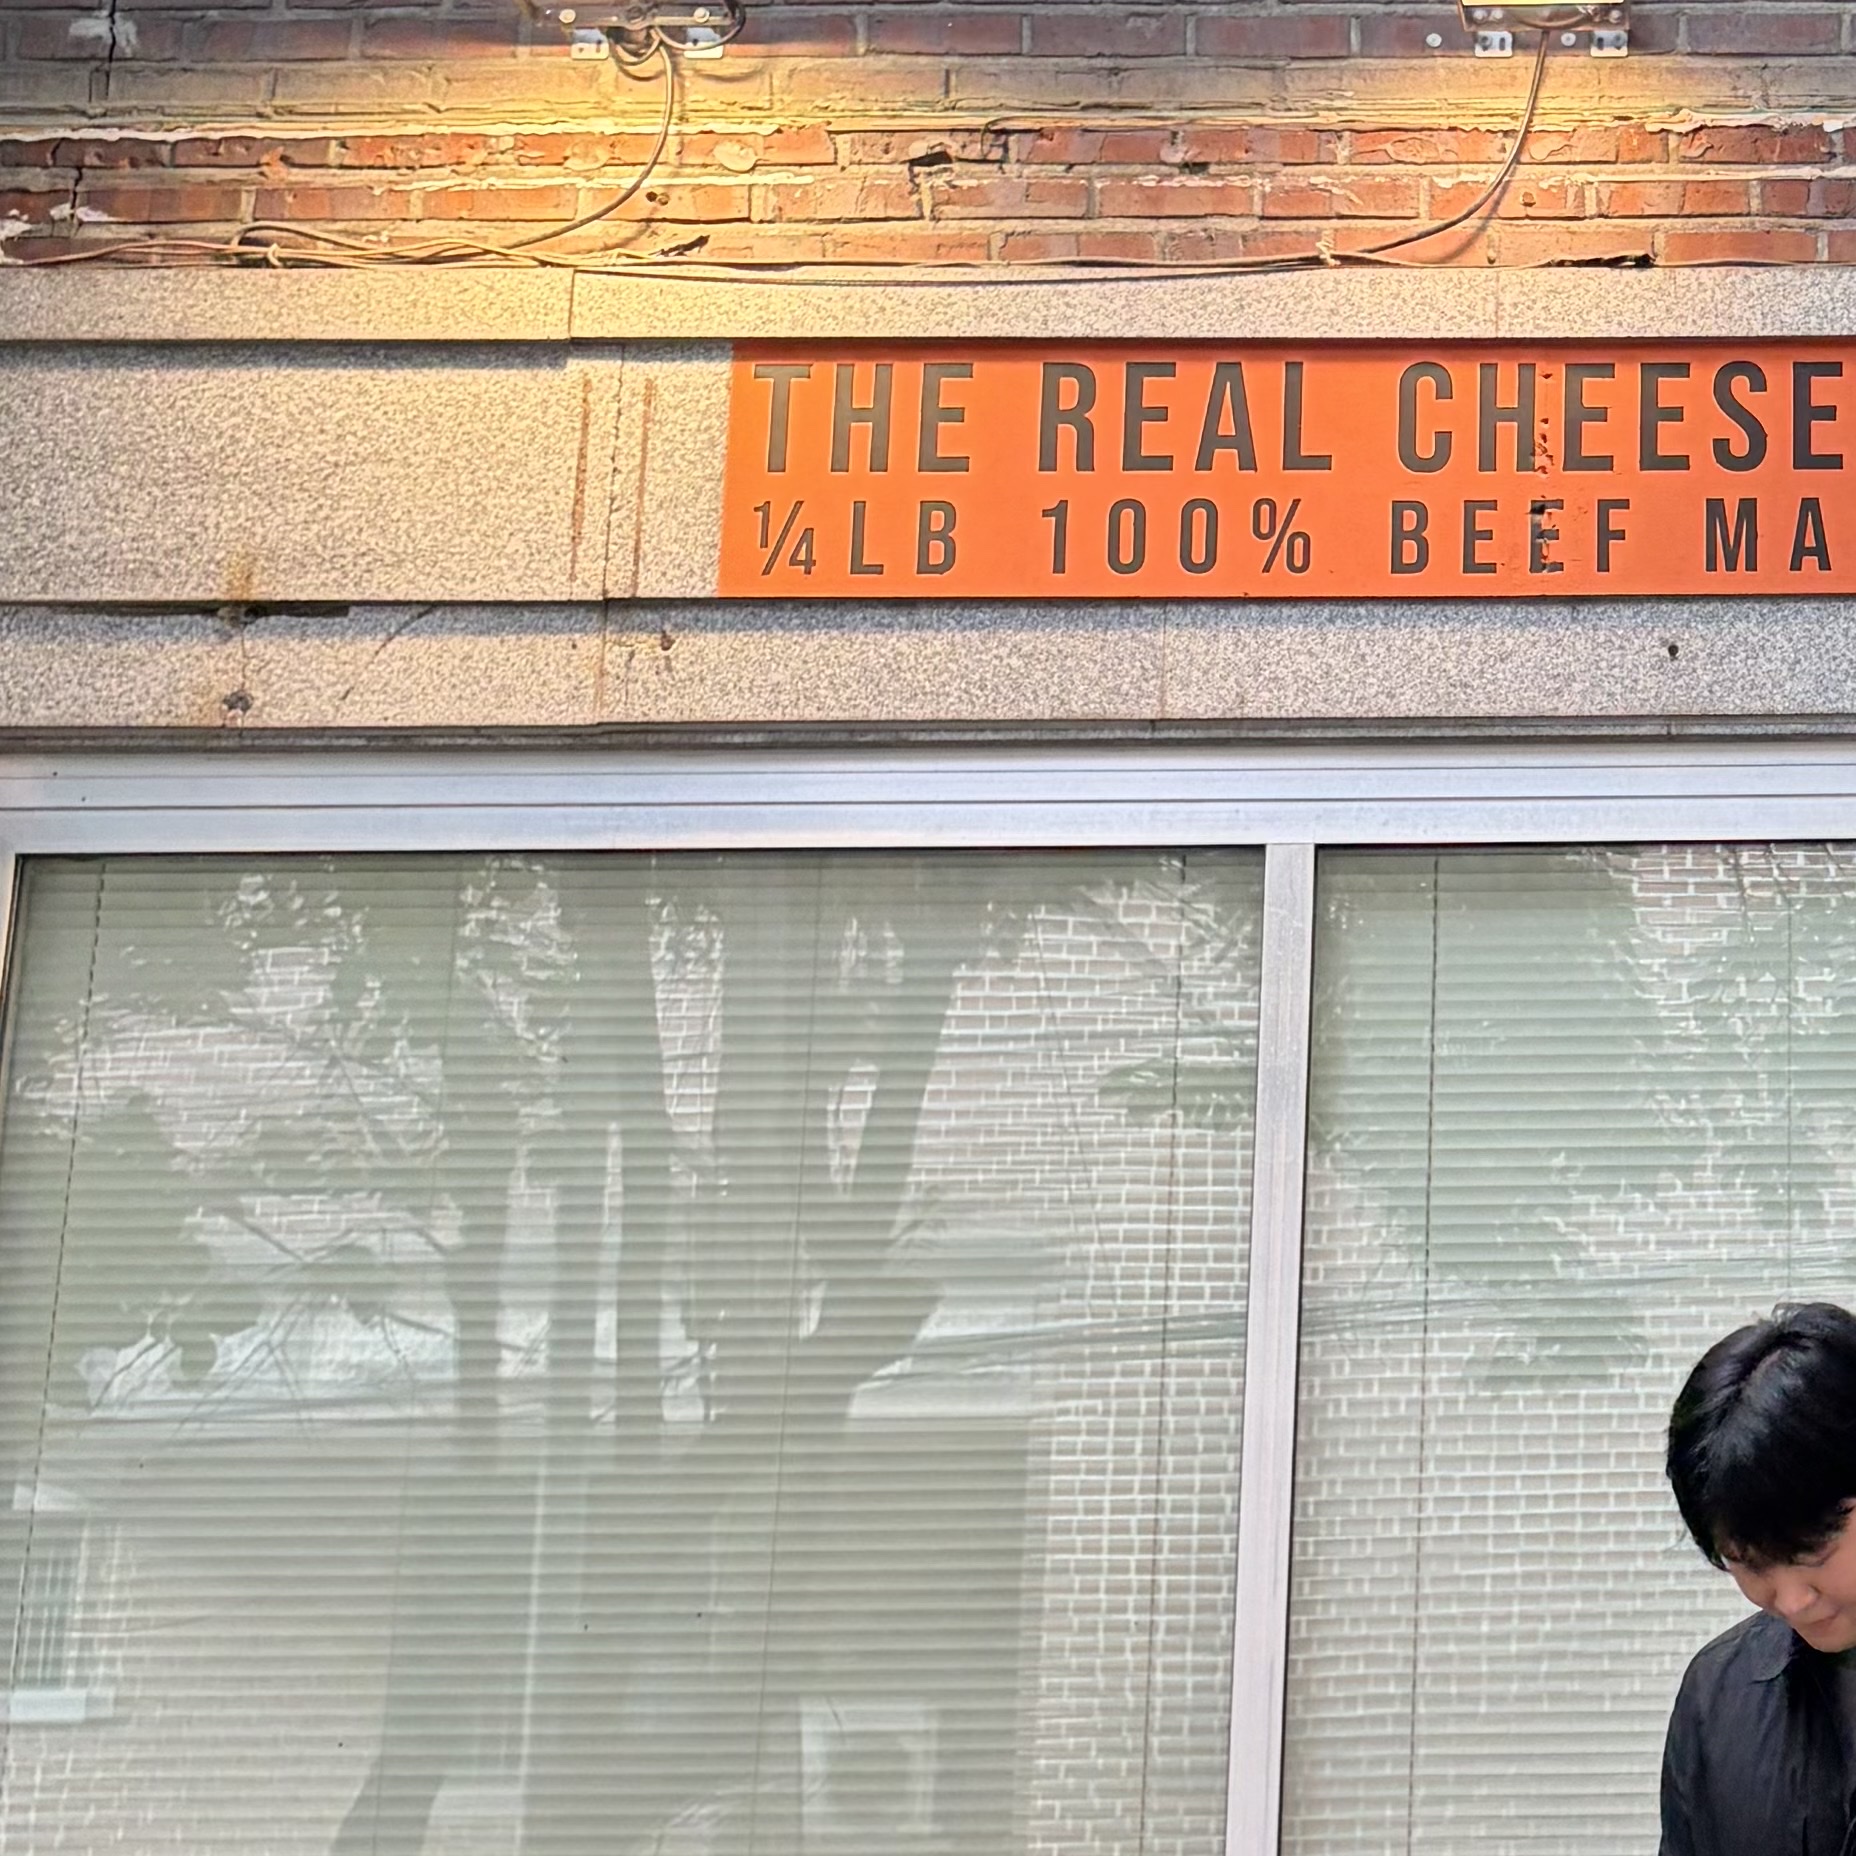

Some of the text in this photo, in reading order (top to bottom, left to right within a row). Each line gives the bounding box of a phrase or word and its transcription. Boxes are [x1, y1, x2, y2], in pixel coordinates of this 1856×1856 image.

[753, 361, 974, 474] THE
[1037, 360, 1332, 474] REAL
[1041, 497, 1311, 575] 100%
[1390, 497, 1630, 576] BEEF
